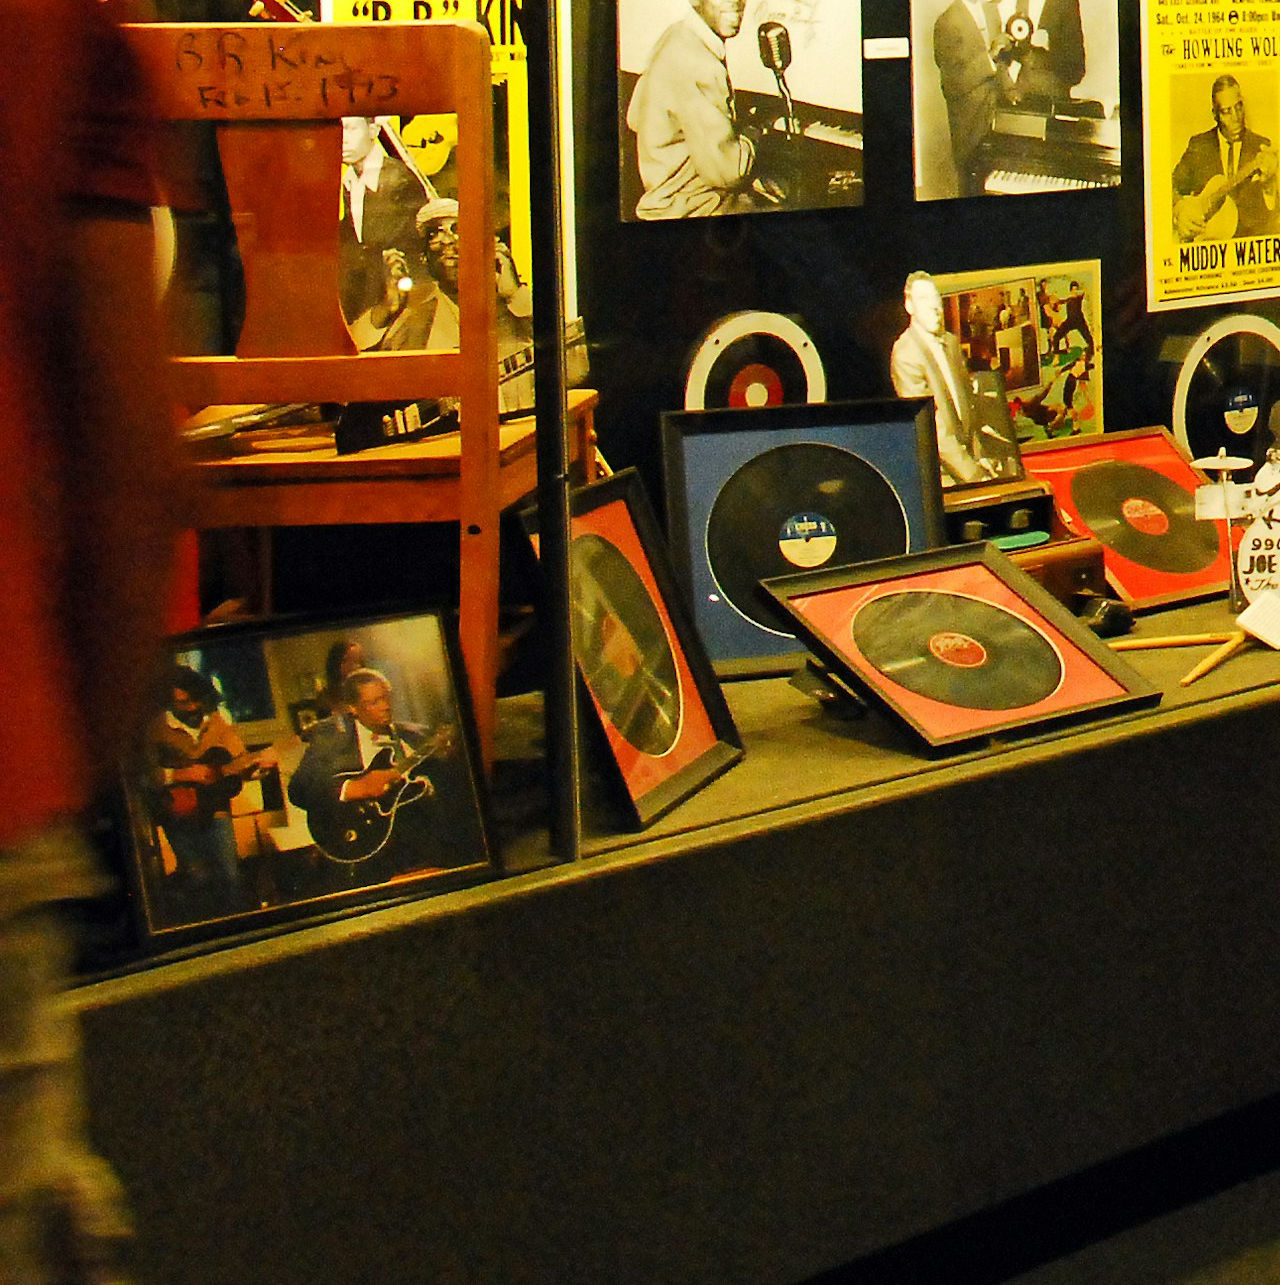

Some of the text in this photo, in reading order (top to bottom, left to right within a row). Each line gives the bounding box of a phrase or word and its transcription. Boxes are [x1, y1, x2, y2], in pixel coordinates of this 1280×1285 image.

[476, 0, 527, 45] KIN
[1208, 12, 1225, 23] 1964
[1183, 37, 1243, 60] HOWLING
[1180, 243, 1227, 273] MUDDY
[1242, 554, 1278, 574] JOE
[1250, 578, 1279, 591] The
